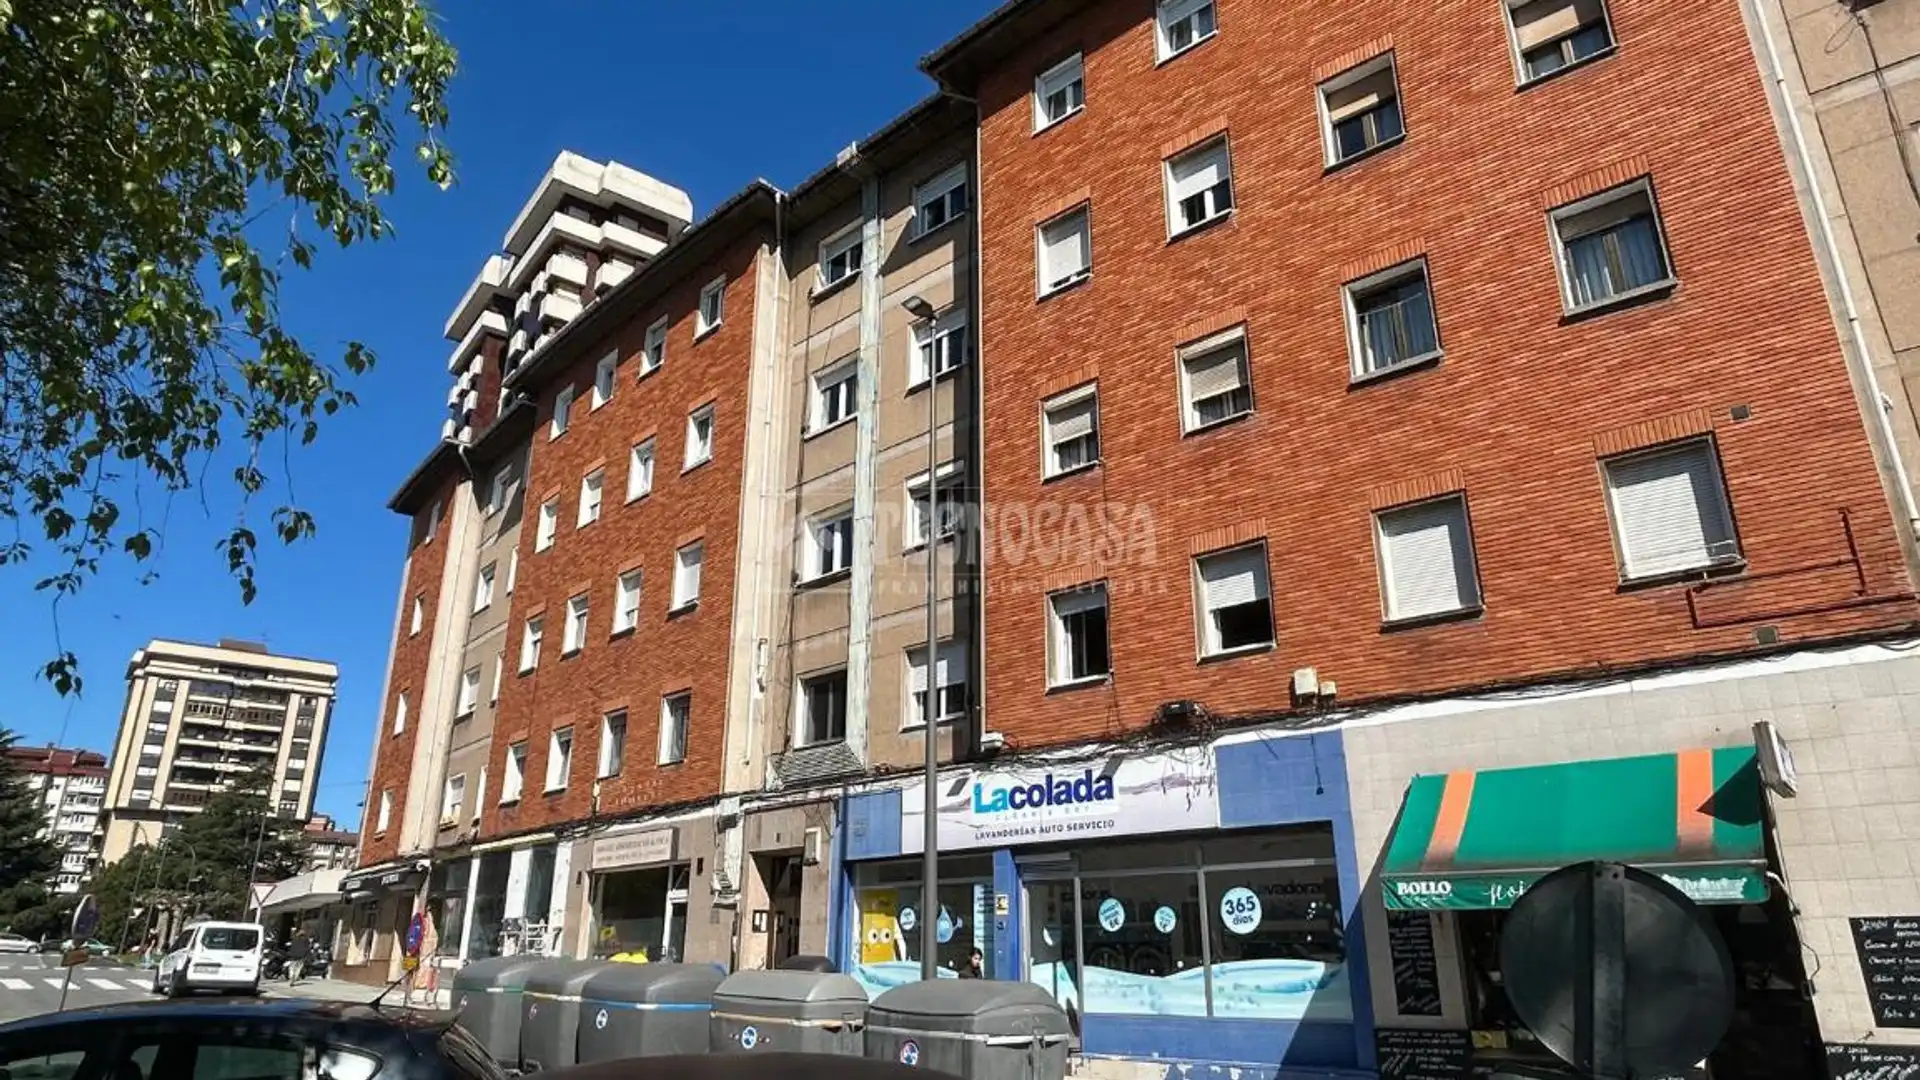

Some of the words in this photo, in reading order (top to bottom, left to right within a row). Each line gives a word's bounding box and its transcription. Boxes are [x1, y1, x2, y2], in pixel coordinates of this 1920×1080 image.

[1039, 823, 1064, 834] AUTO
[1066, 819, 1115, 832] SERVICIO
[1397, 881, 1452, 896] BOLLO
[1225, 895, 1256, 915] 365
